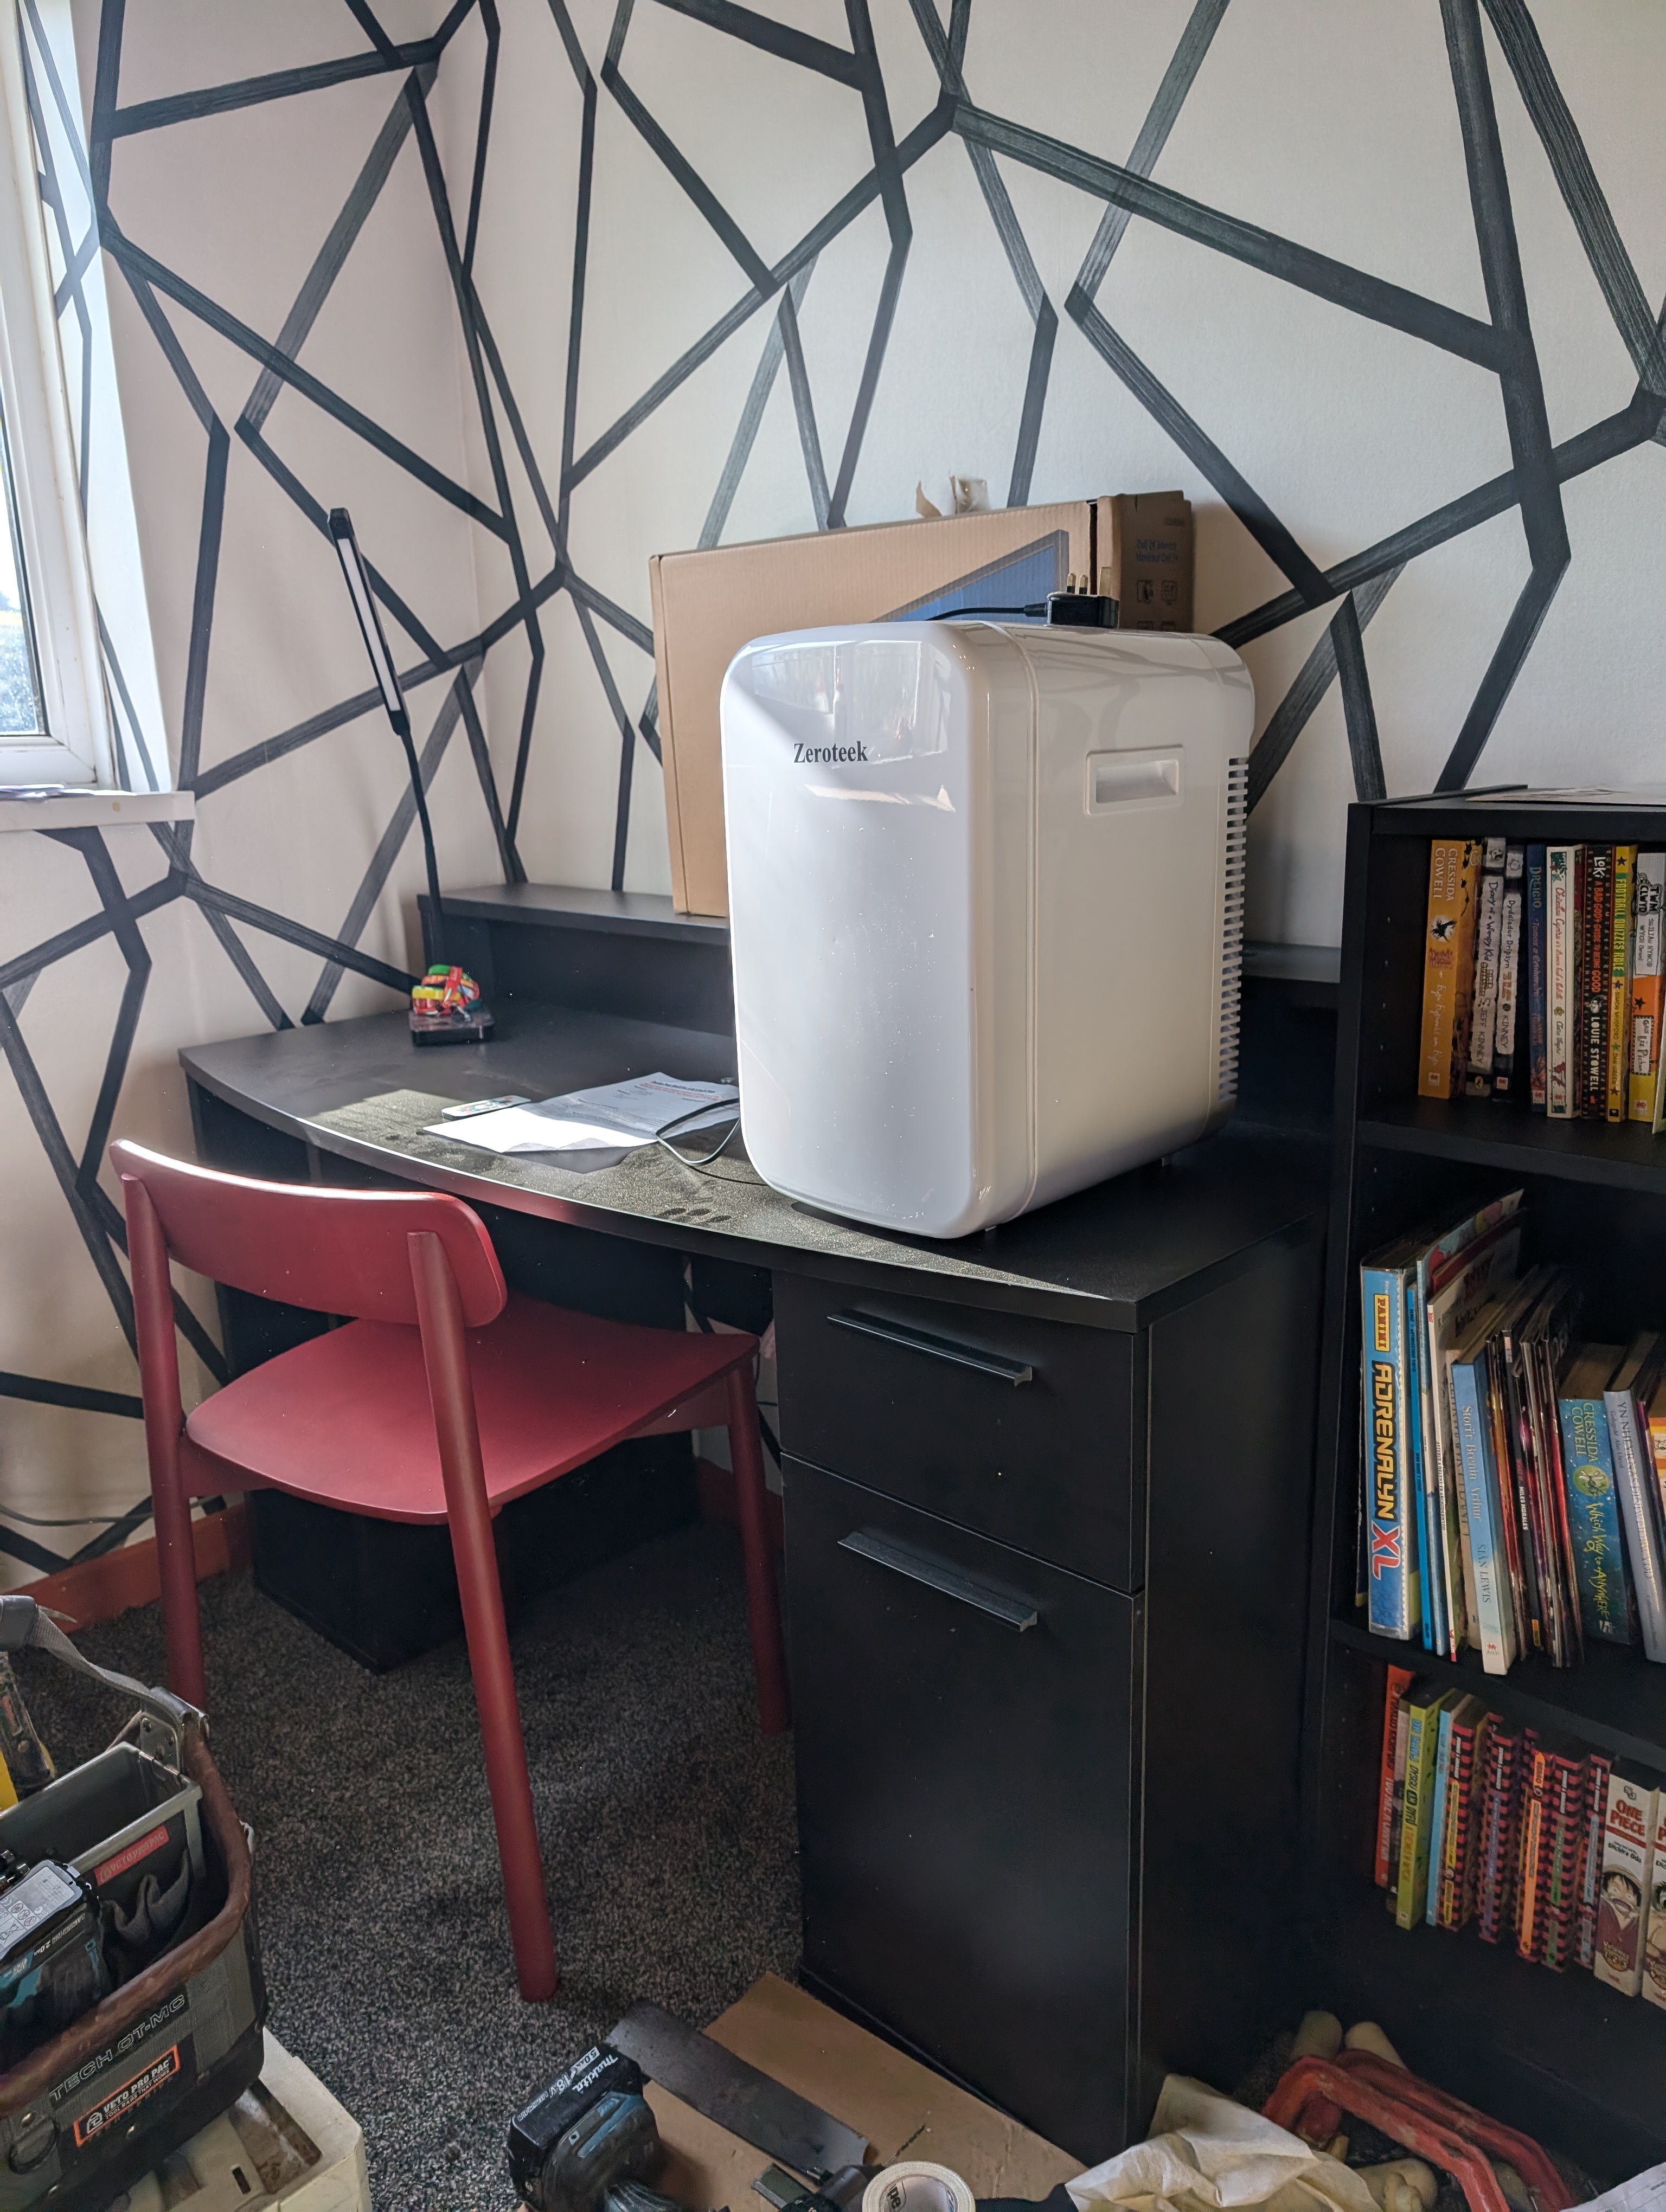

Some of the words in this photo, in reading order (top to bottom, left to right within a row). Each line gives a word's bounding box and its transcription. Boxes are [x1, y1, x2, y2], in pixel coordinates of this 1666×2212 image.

[793, 741, 869, 763] Zeroteek
[1432, 847, 1445, 901] COWELL
[1445, 848, 1457, 901] CRESSIDA
[1487, 882, 1498, 905] Diary
[1593, 886, 1601, 903] BAD
[1614, 878, 1627, 916] FOOTBALL
[1638, 885, 1649, 913] CLWYD
[1649, 886, 1658, 912] TWM
[1506, 899, 1515, 938] Dyddiadur
[1483, 922, 1494, 947] Wimpy
[1613, 918, 1625, 949] QUIZZES
[1483, 948, 1494, 961] Kid
[1503, 940, 1512, 969] Dripsyn
[1592, 951, 1600, 969] BEING
[1612, 952, 1624, 971] RULE
[1591, 969, 1600, 992] GOOD
[1500, 1015, 1509, 1048] KINNEY
[1590, 1017, 1599, 1044] LOUIE
[1637, 1036, 1649, 1047] Liz
[1476, 1031, 1485, 1063] KINNEY
[1634, 1048, 1649, 1073] Pichon
[1588, 1047, 1599, 1091] STOWELL
[1376, 1298, 1387, 1348] PANINI
[1617, 1401, 1629, 1418] YN
[1373, 1362, 1398, 1522] ADRENALYN
[1571, 1405, 1586, 1457] COWELL
[1582, 1401, 1599, 1463] CRESSIDA
[1465, 1443, 1479, 1480] Brenin
[1470, 1485, 1483, 1522] Arthur
[1517, 1486, 1526, 1503] MILES
[1520, 1503, 1528, 1531] MORALES
[1585, 1501, 1606, 1533] Which
[1371, 1520, 1401, 1581] XL
[1476, 1544, 1488, 1568] SIÂN
[1582, 1533, 1609, 1557] Way
[1594, 1556, 1601, 1565] to
[1479, 1570, 1491, 1603] LEWIS
[1588, 1566, 1611, 1621] ANYWHERE
[1412, 1719, 1421, 1734] DR
[1409, 1734, 1420, 1763] RANJ
[1408, 1765, 1418, 1789] DYSGU
[1405, 1806, 1416, 1825] DYFU
[1610, 1809, 1645, 1836] PIECE
[1616, 1799, 1642, 1821] ONE
[1630, 1853, 1642, 1863] Oda
[49, 2049, 112, 2101] TECH
[104, 2091, 129, 2113] VETO
[131, 2074, 149, 2094] PRO
[151, 2059, 170, 2078] PAC
[105, 2107, 121, 2120] TOOL
[121, 2095, 138, 2109] BAGS
[138, 2084, 153, 2097] THAT
[153, 2069, 170, 2085] WORK
